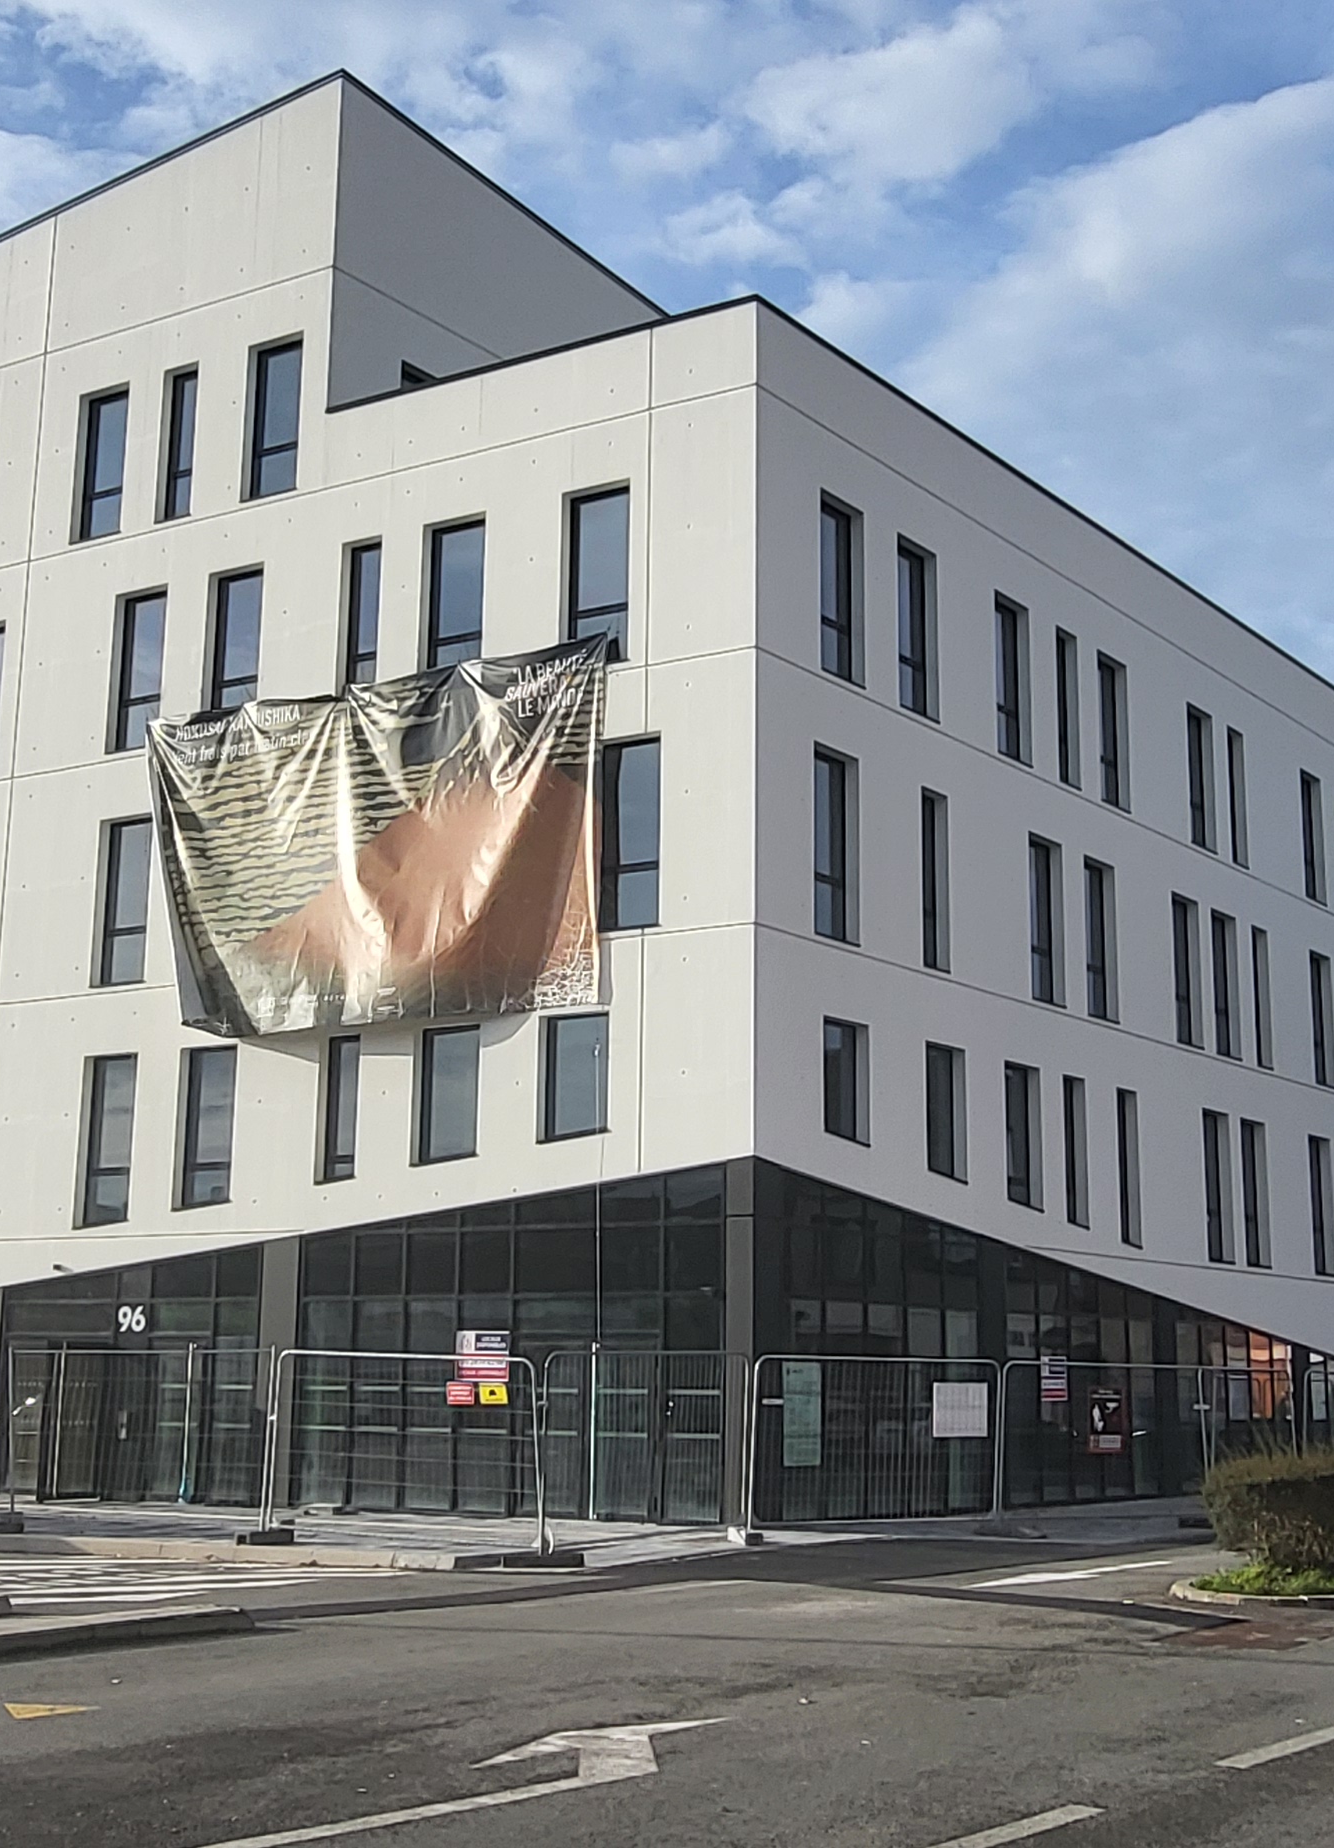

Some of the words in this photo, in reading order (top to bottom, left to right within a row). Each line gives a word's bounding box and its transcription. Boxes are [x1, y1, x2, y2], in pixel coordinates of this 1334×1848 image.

[536, 649, 587, 680] BEAUTÉ
[505, 675, 568, 702] SAUVERA
[518, 698, 535, 718] LE
[118, 1305, 146, 1332] 96
